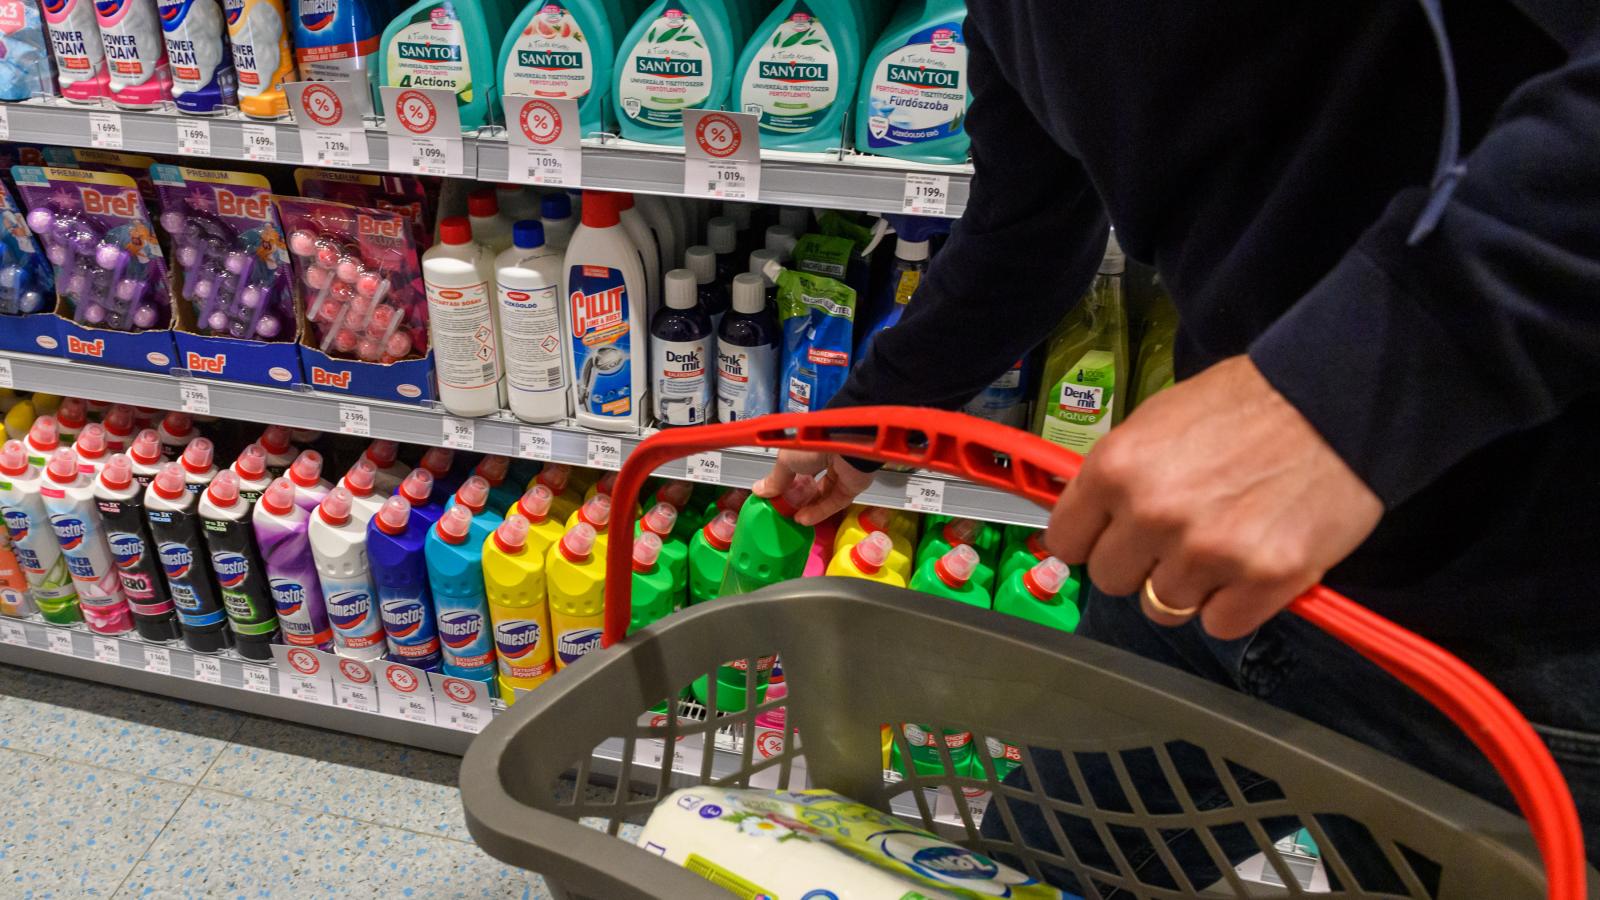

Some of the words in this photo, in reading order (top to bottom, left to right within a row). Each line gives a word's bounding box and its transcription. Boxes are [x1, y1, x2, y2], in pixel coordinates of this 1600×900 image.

[401, 44, 460, 61] SANYTOL
[521, 53, 580, 67] SANYTOL
[639, 60, 699, 74] SANYTOL
[762, 65, 825, 79] SANYTOL
[890, 68, 955, 86] SANYTOL
[400, 75, 412, 87] 4
[414, 75, 457, 88] Actions
[890, 95, 949, 111] Fürdőszoba
[50, 170, 94, 180] PREMIUM
[186, 168, 229, 180] PREMIUM
[83, 189, 138, 217] Bref
[217, 188, 271, 219] Bref
[358, 214, 402, 238] Bref
[571, 285, 625, 338] CILLIT
[68, 336, 104, 357] Bref
[188, 352, 226, 373] Bref
[666, 351, 699, 363] Denk
[682, 361, 700, 372] mit
[725, 363, 743, 375] mit
[312, 367, 351, 389] Bref
[1064, 386, 1095, 400] Denk
[1077, 399, 1096, 409] mit
[1058, 410, 1096, 423] nature
[122, 578, 146, 591] ZERO
[556, 637, 604, 658] Domesto
